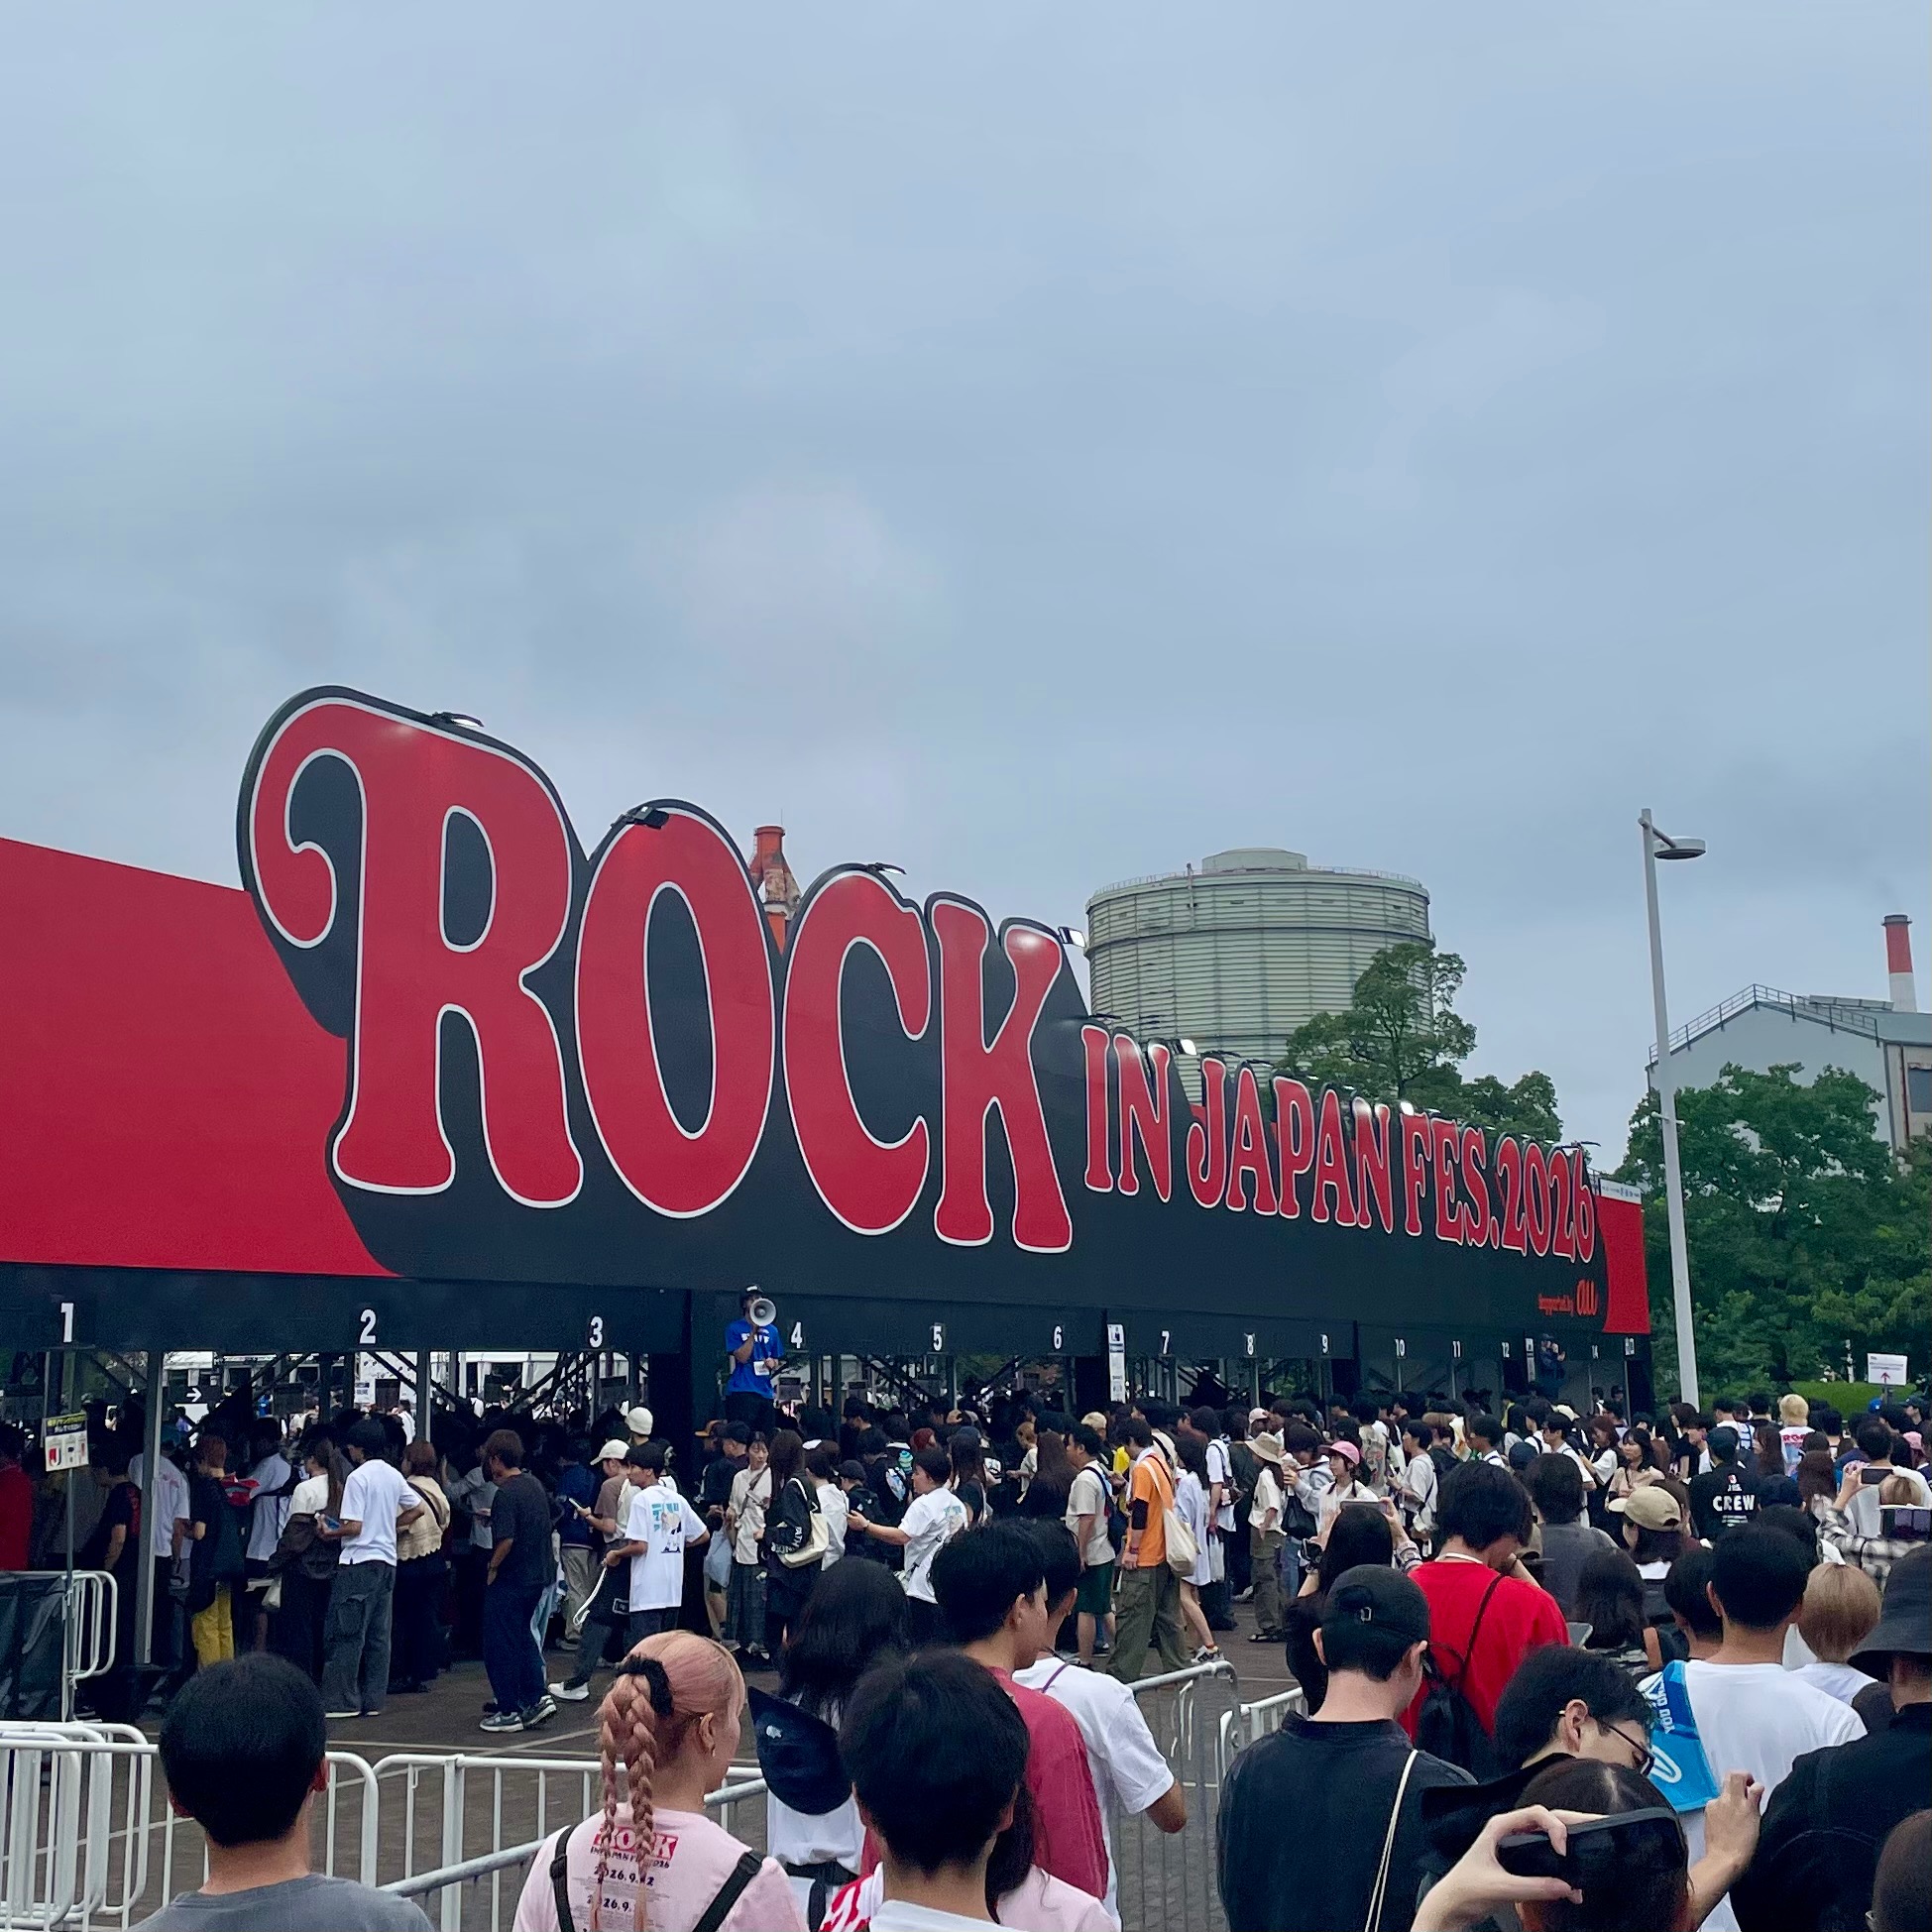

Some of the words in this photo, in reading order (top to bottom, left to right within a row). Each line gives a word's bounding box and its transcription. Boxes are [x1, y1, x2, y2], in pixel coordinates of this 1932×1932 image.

[250, 696, 1074, 1254] ROCK
[1081, 1025, 1173, 1203] IN
[1186, 1057, 1394, 1235] JAPAN
[60, 1303, 74, 1343] 1
[360, 1308, 377, 1344] 2
[589, 1315, 604, 1348] 3
[790, 1321, 803, 1349] 4
[933, 1325, 943, 1351] 5
[1054, 1325, 1062, 1350] 6
[1162, 1330, 1170, 1355] 7
[1247, 1334, 1254, 1356] 8
[1321, 1334, 1328, 1354] 9
[1395, 1338, 1406, 1357] 10
[1452, 1340, 1461, 1358] 11
[1502, 1341, 1510, 1358] 12
[1712, 1495, 1756, 1512] CREW
